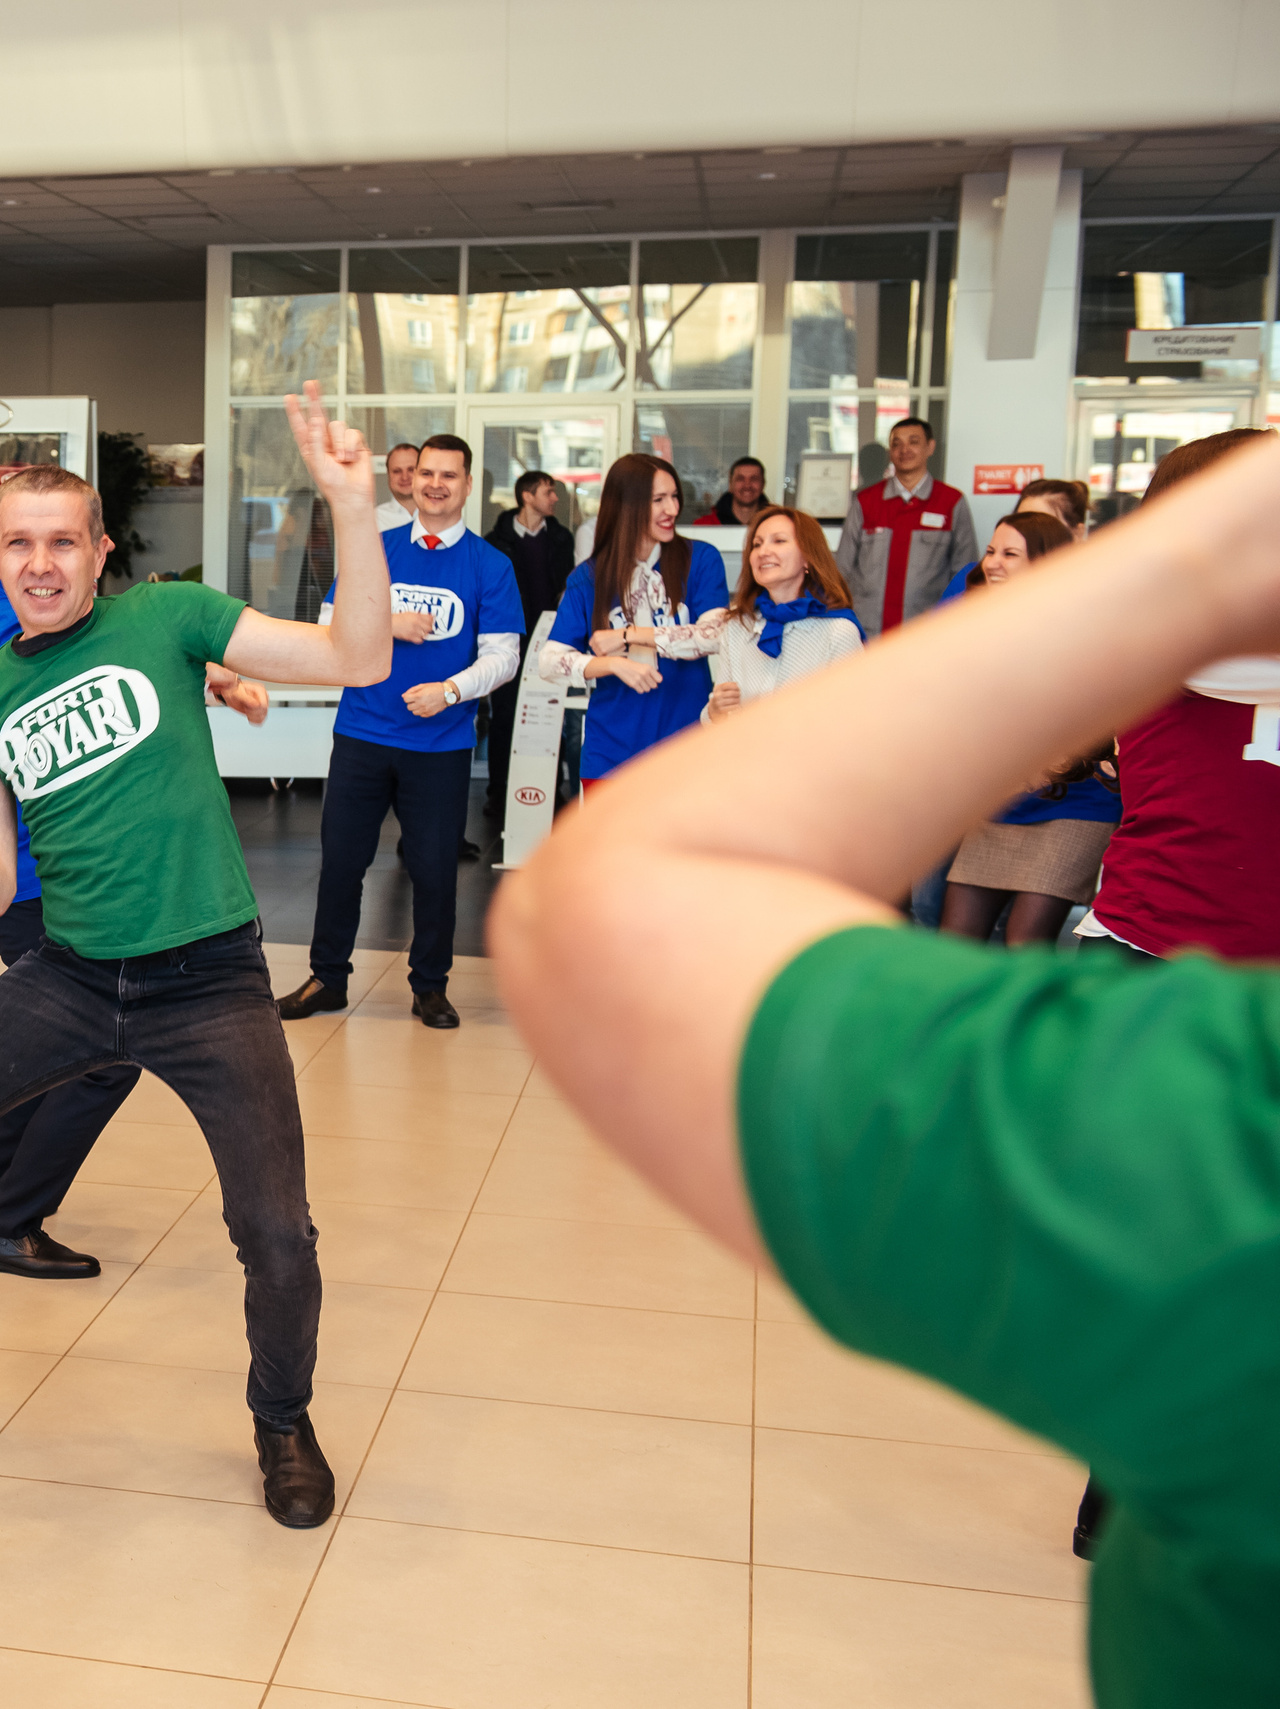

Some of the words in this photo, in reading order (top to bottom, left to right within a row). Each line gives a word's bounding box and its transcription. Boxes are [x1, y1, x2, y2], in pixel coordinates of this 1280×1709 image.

[399, 590, 442, 606] FORT
[21, 680, 96, 736] FORT
[520, 791, 540, 801] KIA
